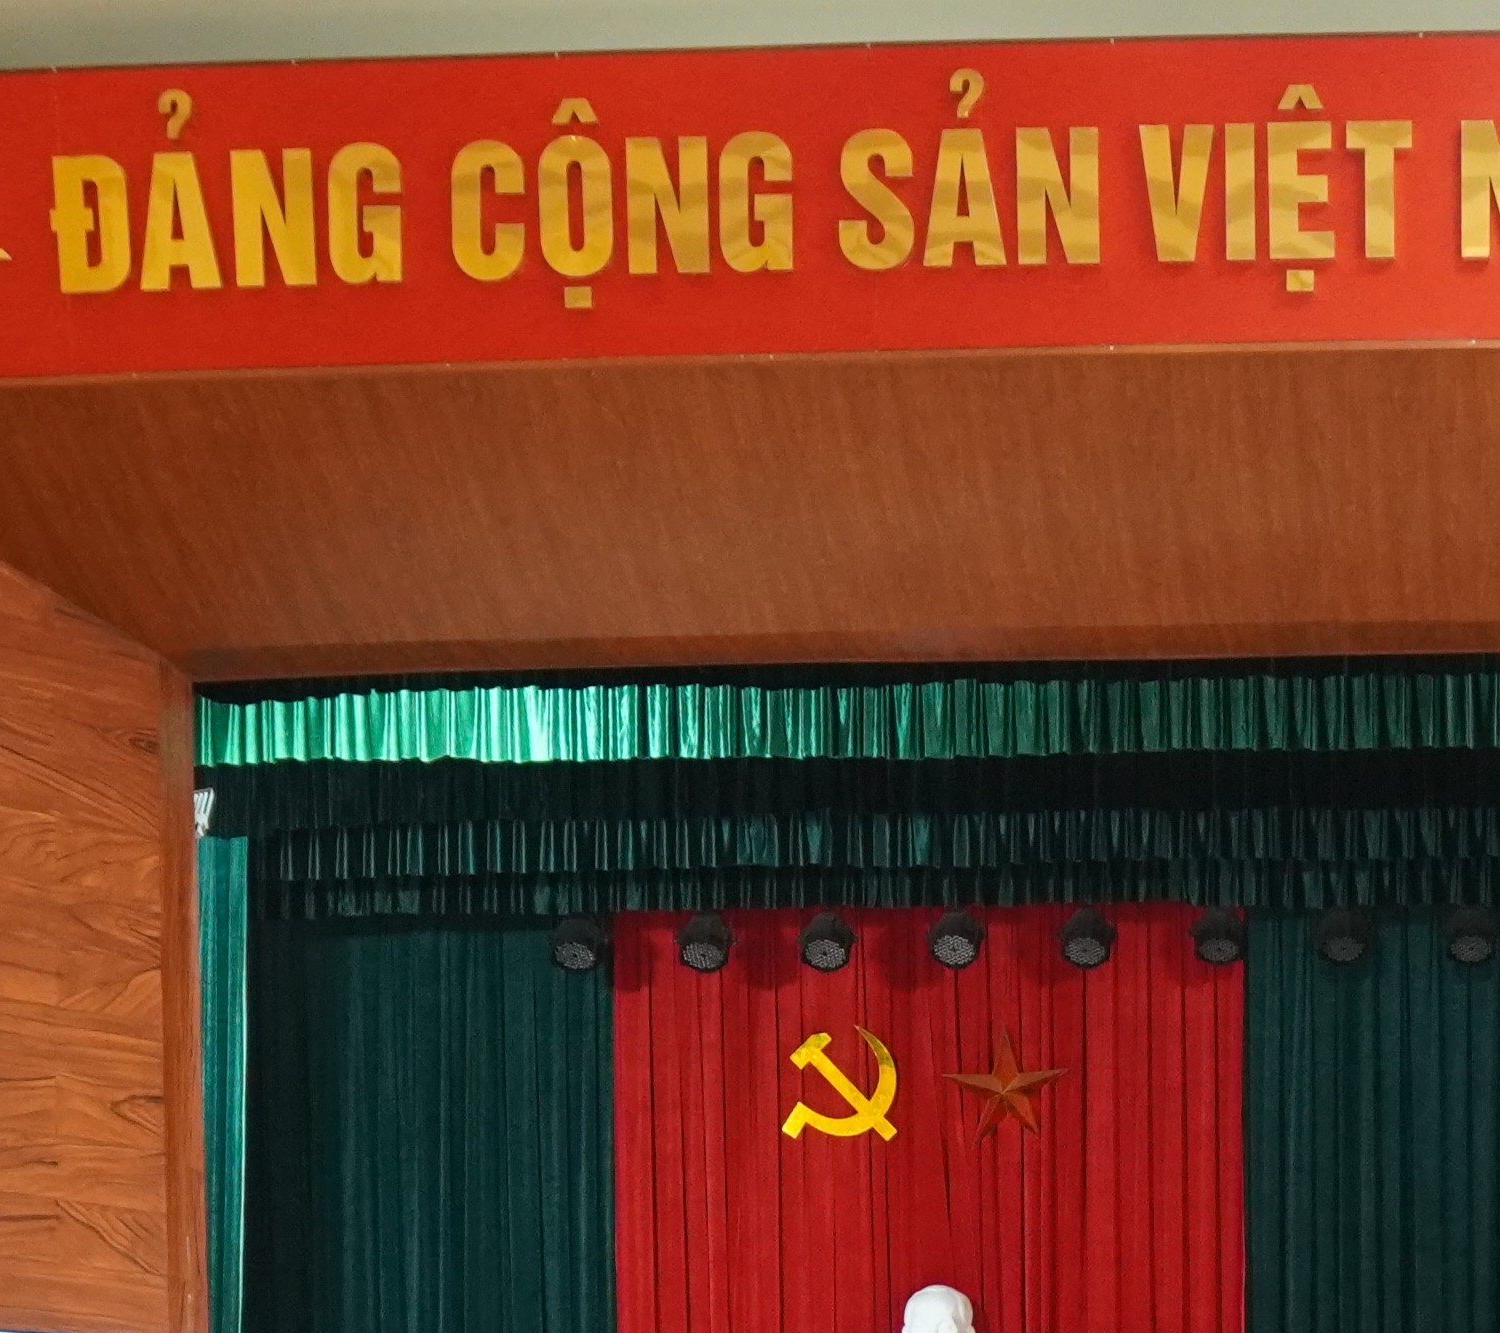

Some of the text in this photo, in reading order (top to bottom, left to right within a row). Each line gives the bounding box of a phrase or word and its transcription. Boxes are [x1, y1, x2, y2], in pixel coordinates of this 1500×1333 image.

[49, 89, 405, 295] ĐẢNG
[450, 98, 796, 310] CỘNG
[839, 67, 1104, 271] SẢN
[1139, 84, 1415, 294] VIỆT
